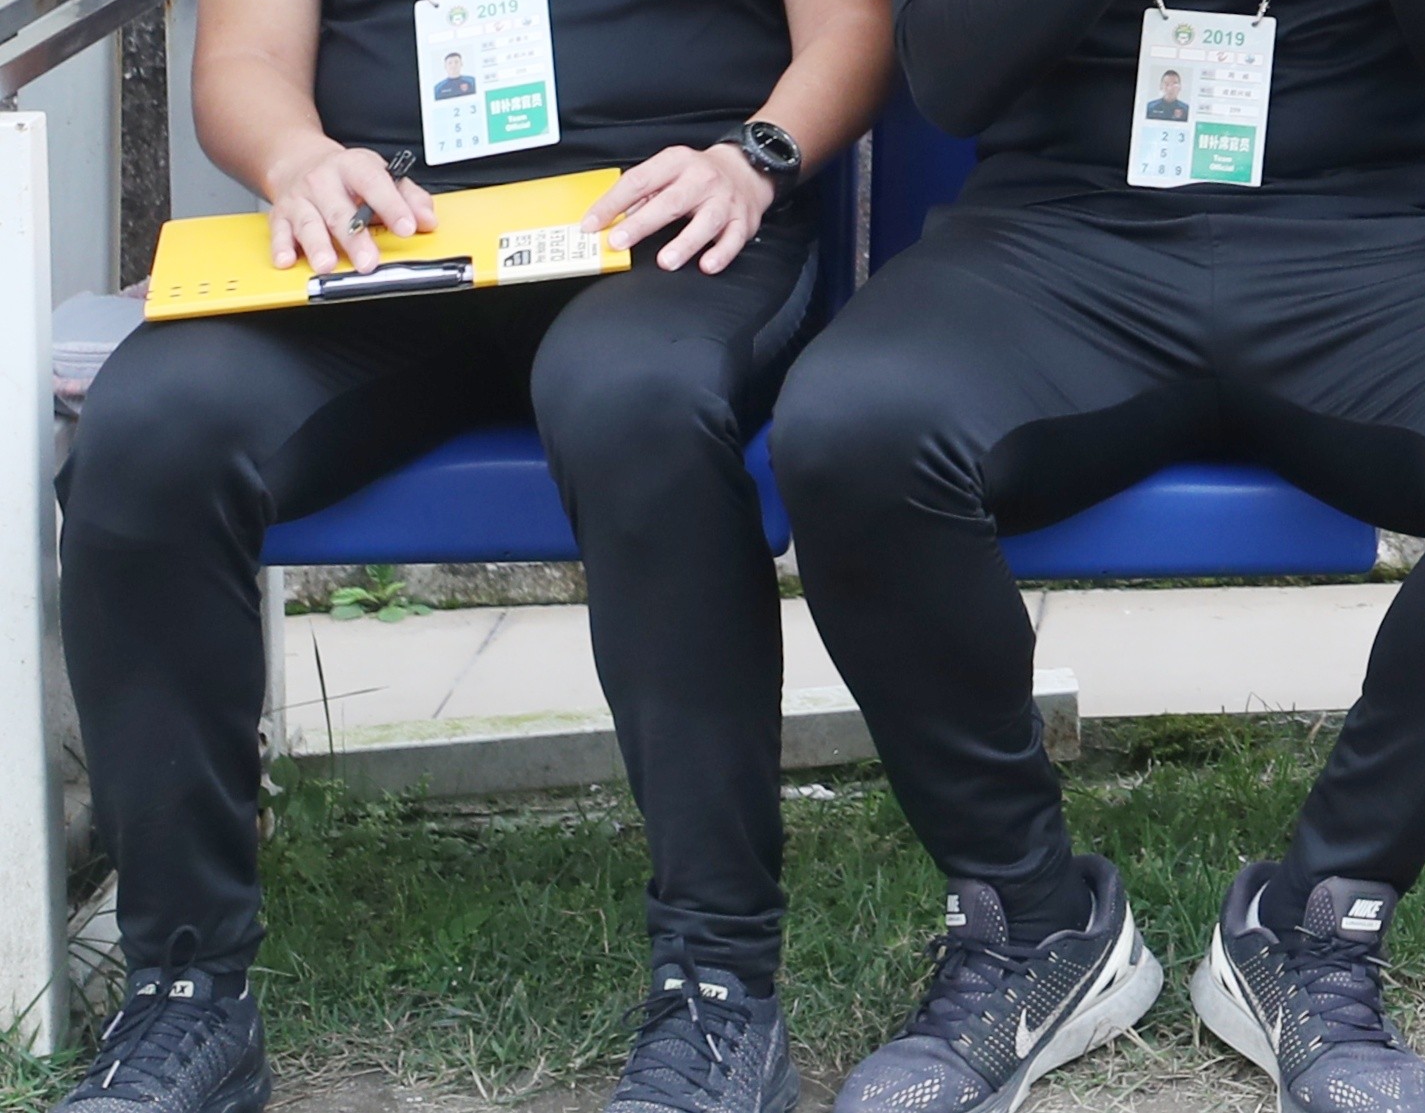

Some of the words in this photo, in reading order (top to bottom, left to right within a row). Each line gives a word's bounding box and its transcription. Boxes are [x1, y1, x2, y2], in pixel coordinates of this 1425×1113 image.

[476, 0, 519, 19] 2019
[1202, 29, 1245, 47] 2019
[453, 107, 460, 118] 2
[470, 105, 477, 115] 3
[455, 123, 462, 133] 5
[438, 141, 445, 151] 7
[455, 138, 463, 148] 8
[472, 135, 479, 145] 9
[1162, 131, 1169, 142] 2
[1178, 132, 1185, 143] 3
[1160, 148, 1167, 158] 5
[1142, 163, 1149, 173] 7
[1158, 164, 1165, 174] 8
[1175, 165, 1182, 176] 9
[1348, 898, 1384, 919] NIKE
